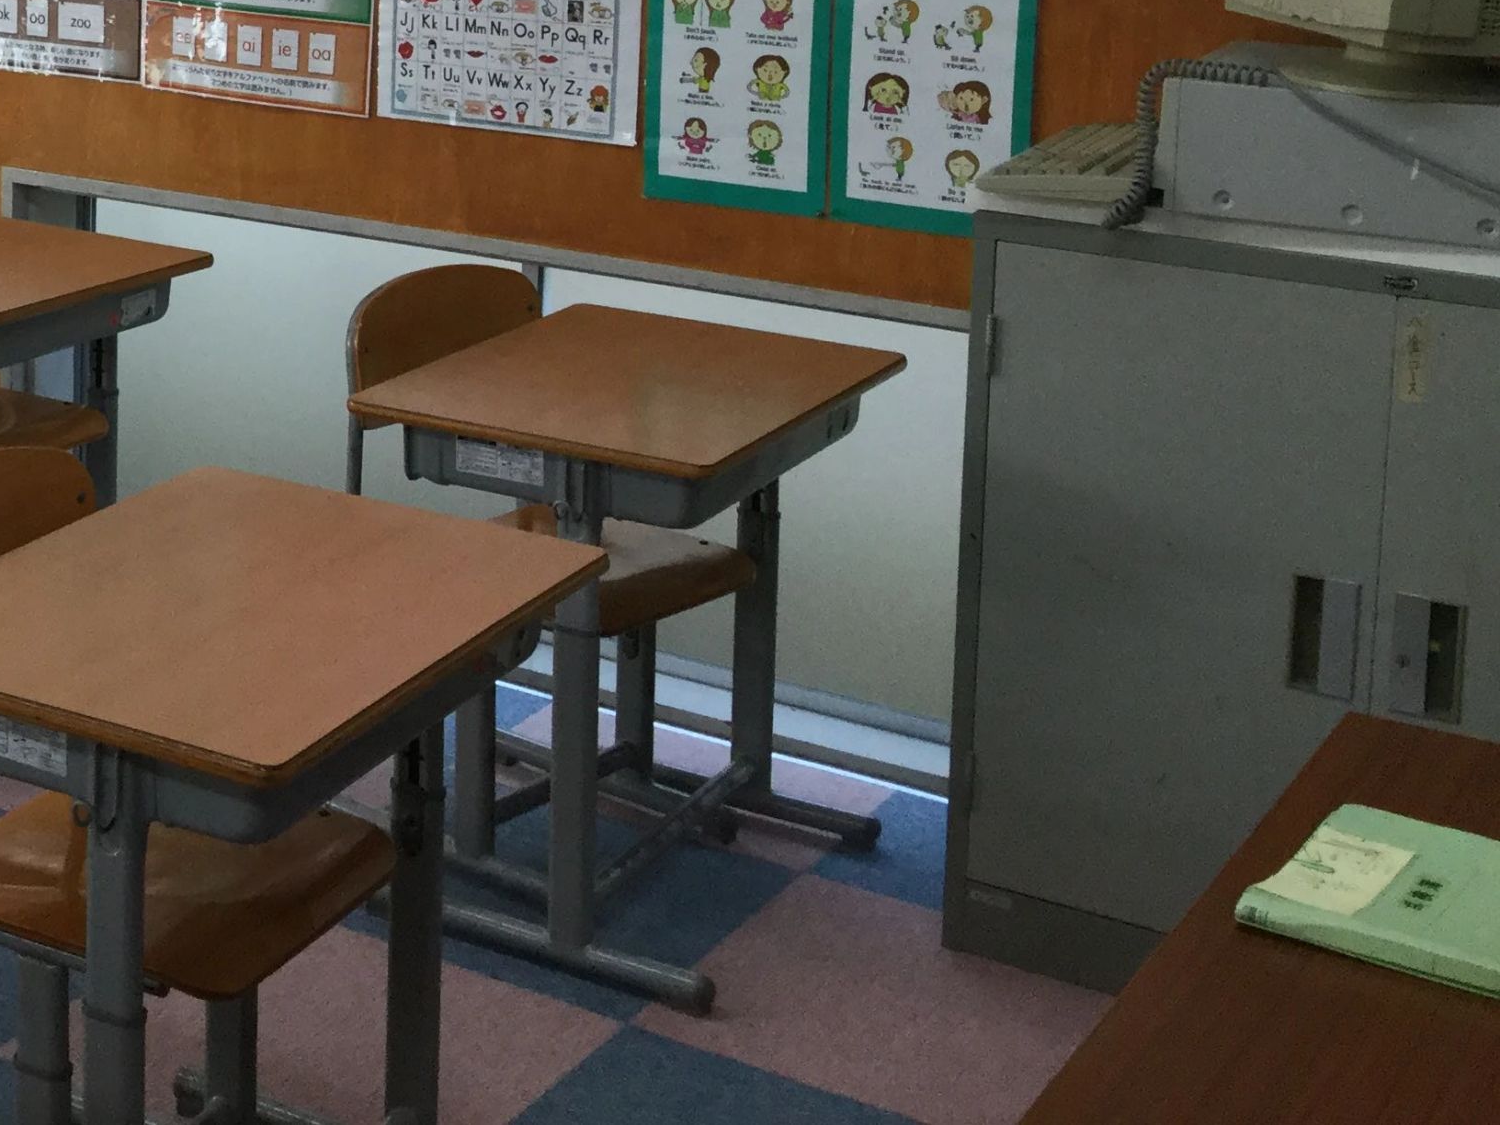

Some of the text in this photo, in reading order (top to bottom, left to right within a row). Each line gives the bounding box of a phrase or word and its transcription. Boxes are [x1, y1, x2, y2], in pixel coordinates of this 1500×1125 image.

[30, 14, 46, 25] oo
[71, 17, 91, 29] zoo
[401, 12, 609, 49] Jj Kk Ll Mm Nn Oo Pp Qq Rr
[242, 37, 255, 52] ai
[278, 40, 292, 57] ie
[312, 48, 331, 61] oa
[401, 63, 583, 98] Ss Tt Uu Vv Ww Xx Yy Zz
